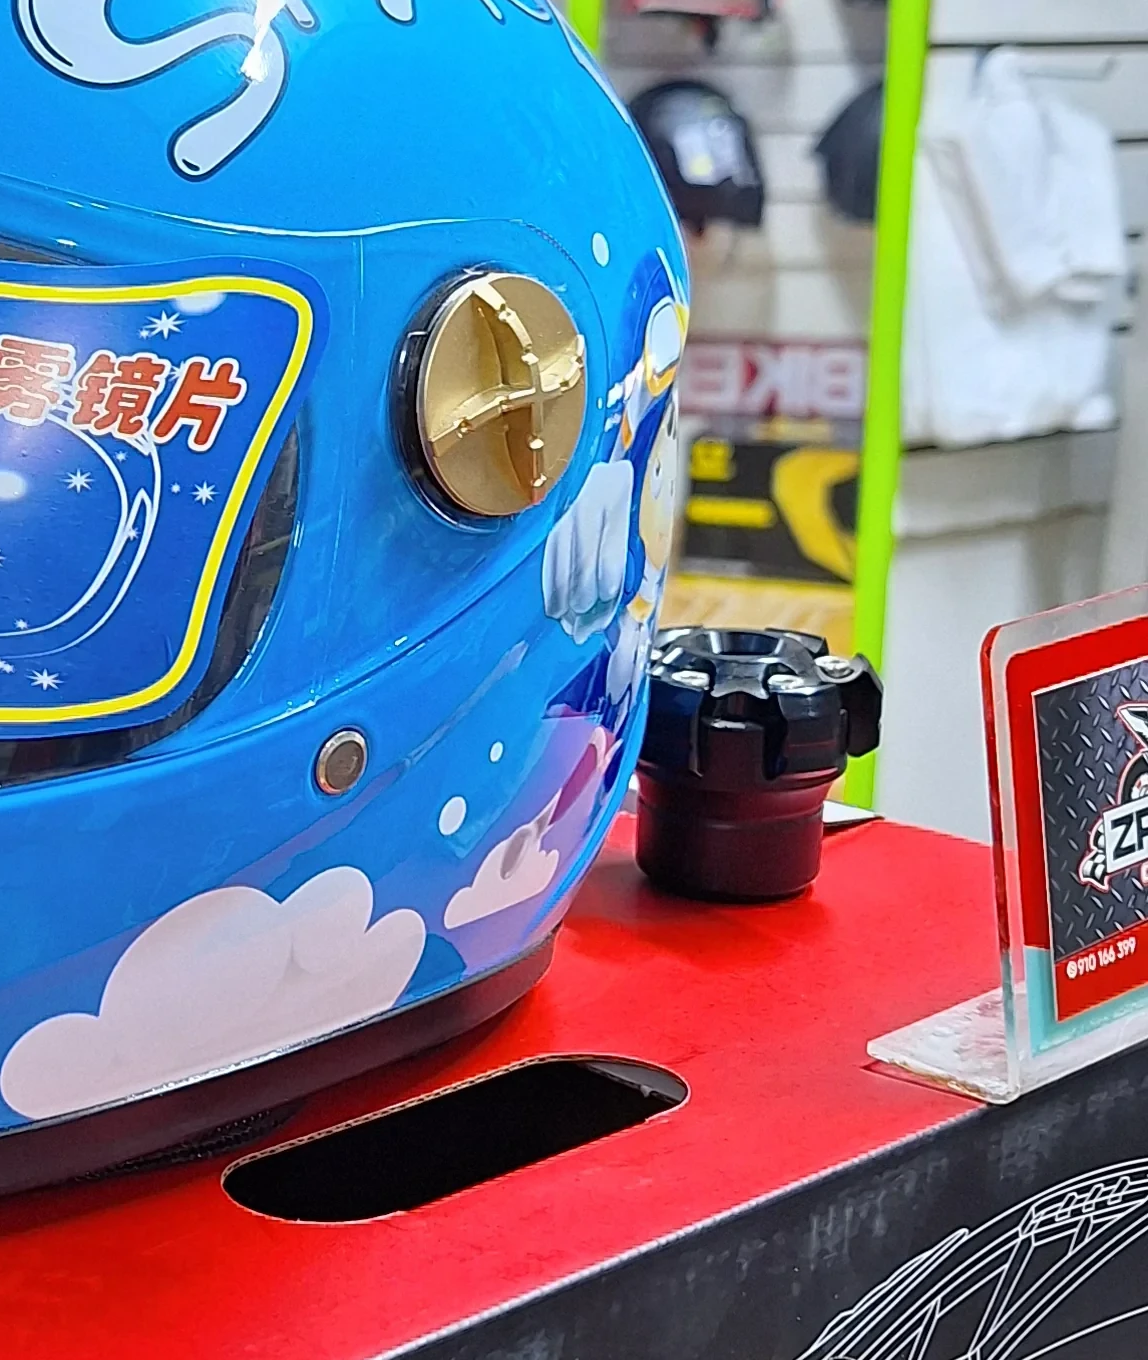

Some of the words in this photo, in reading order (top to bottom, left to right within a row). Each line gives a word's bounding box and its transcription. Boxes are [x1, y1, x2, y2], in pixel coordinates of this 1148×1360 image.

[1077, 953, 1097, 976] 910
[1098, 945, 1116, 967] 166
[1117, 937, 1136, 959] 399
